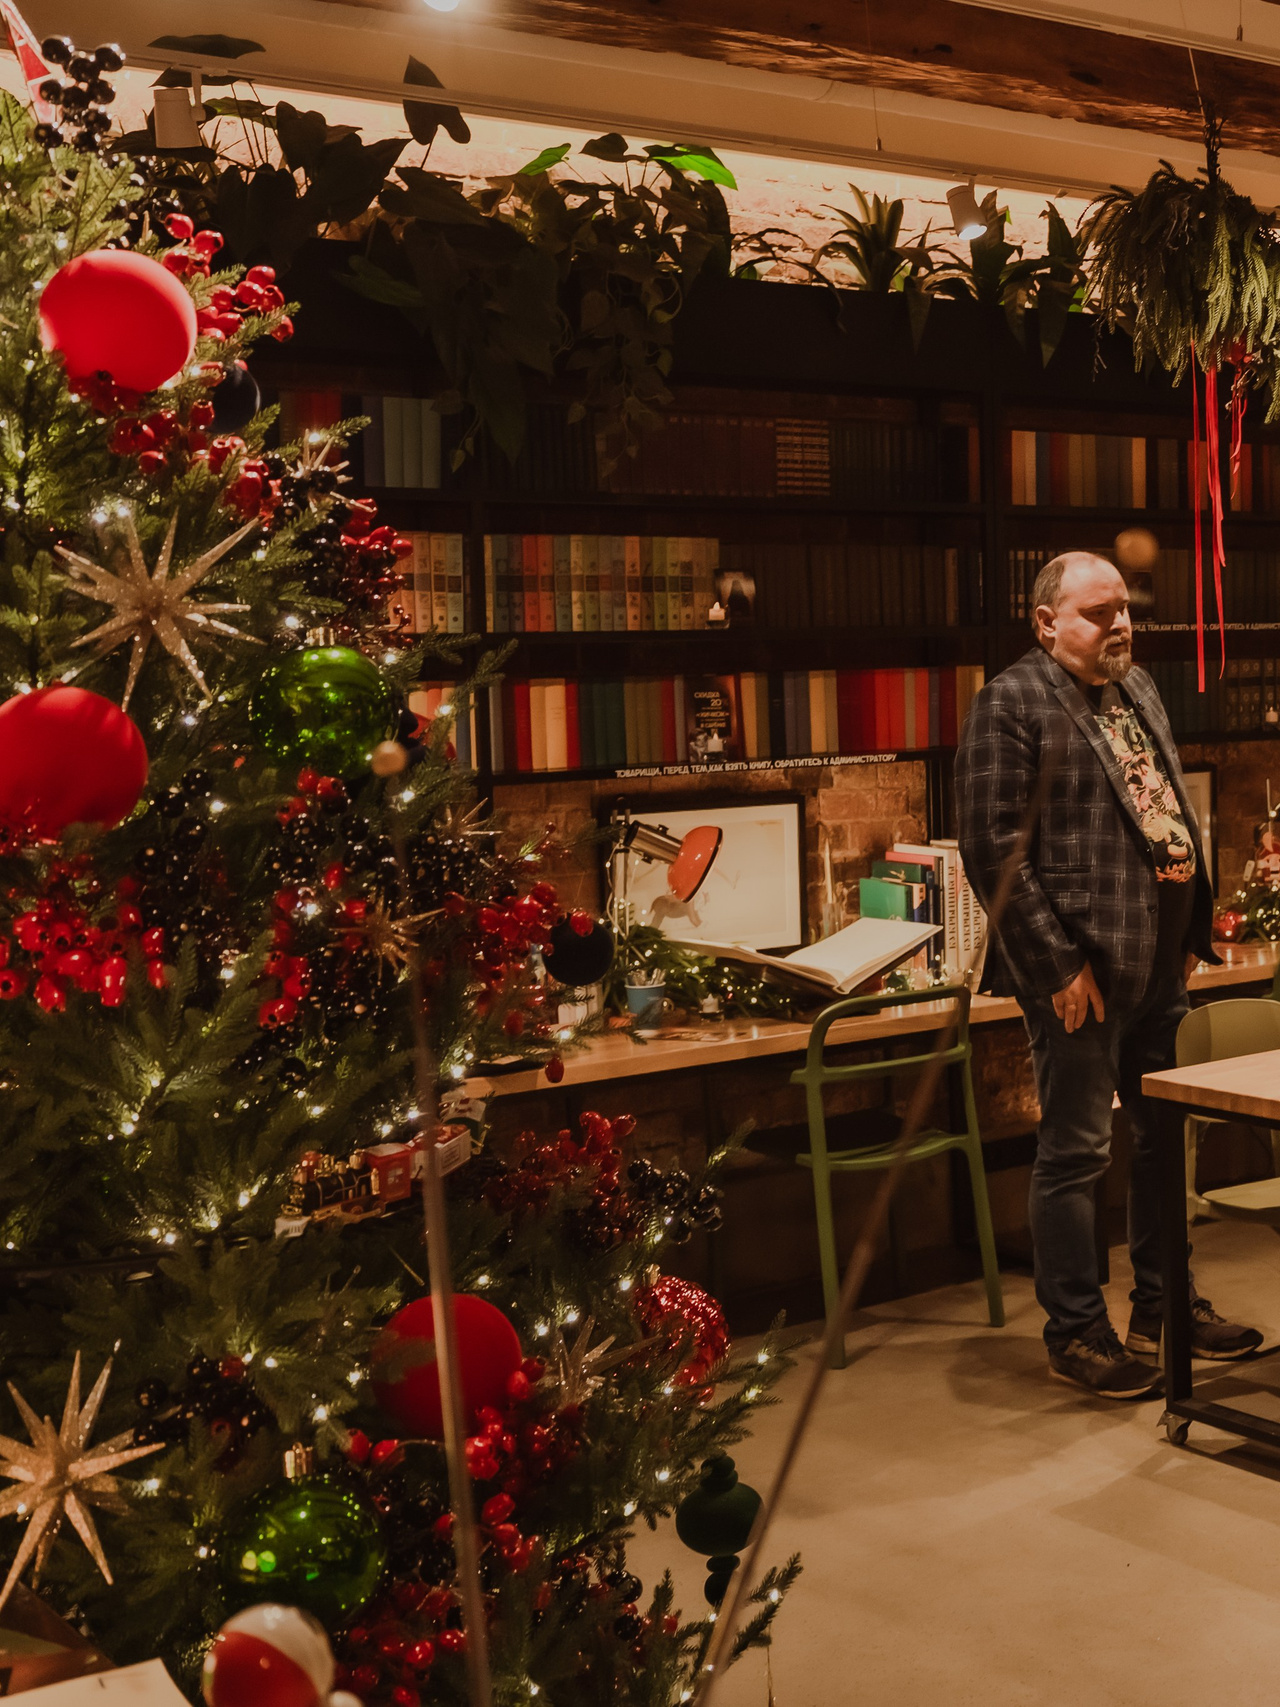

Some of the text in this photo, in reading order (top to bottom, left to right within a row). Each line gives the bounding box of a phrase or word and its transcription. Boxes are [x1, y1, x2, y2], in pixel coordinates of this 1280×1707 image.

[1209, 623, 1245, 631] ОБРТИТЕСЬ
[614, 767, 662, 778] ТОВАРИЩИ,
[663, 765, 690, 776] ПЕРЕД
[724, 762, 748, 772] ВЗЯТЬ
[749, 760, 774, 770] КНИГУ,
[775, 757, 823, 769] ОБРАТИТЕСЬ
[823, 758, 829, 766] К
[829, 753, 898, 766] АДМИНИСТРАТОРУ
[948, 866, 956, 949] КУКРЫНИКСЫ
